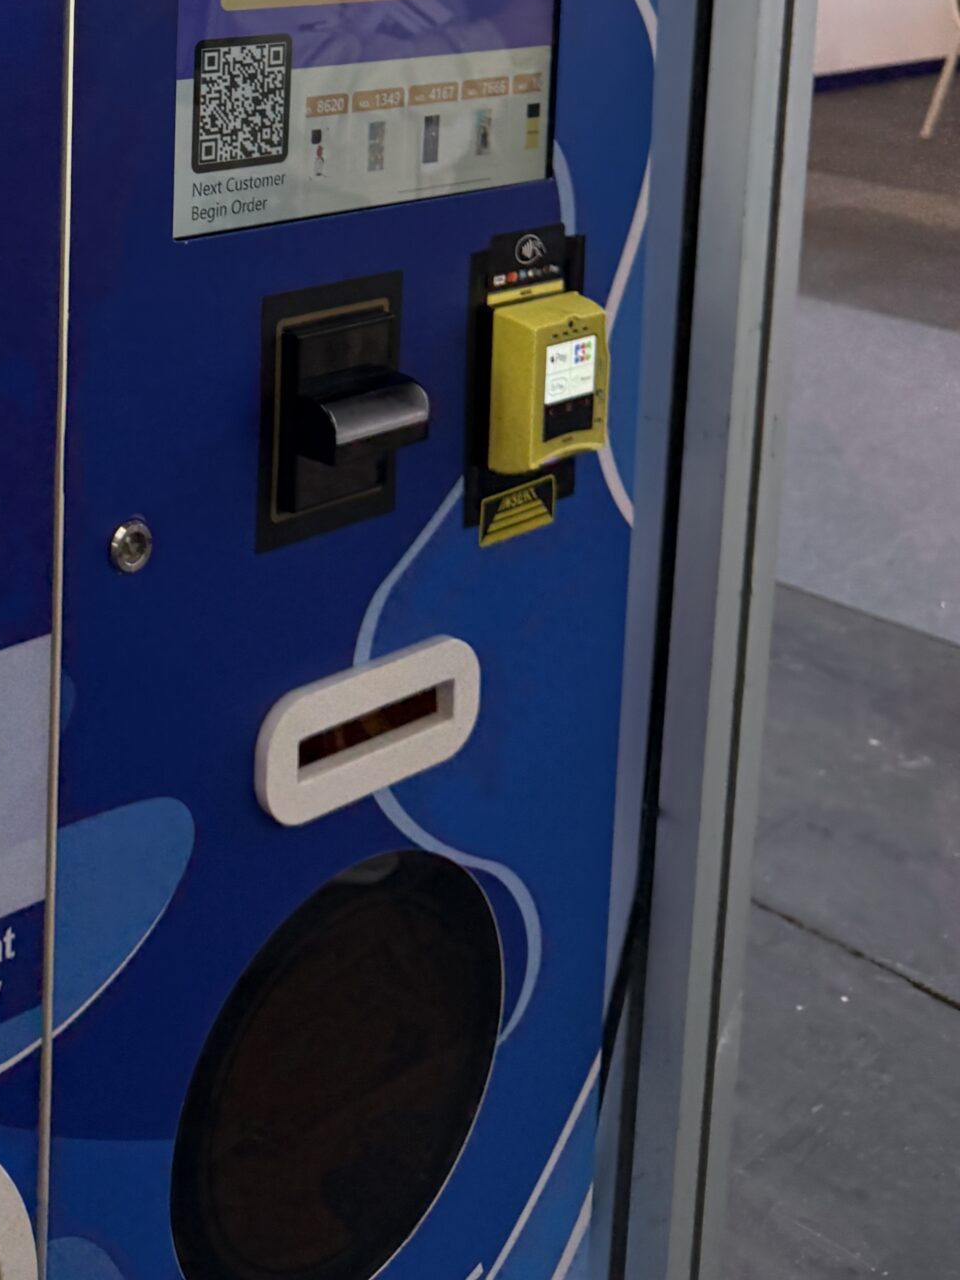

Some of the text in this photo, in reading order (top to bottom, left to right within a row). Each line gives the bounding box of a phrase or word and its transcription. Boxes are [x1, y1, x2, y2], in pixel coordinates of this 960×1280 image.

[191, 173, 286, 198] Next Customer
[191, 197, 268, 223] Begin Order
